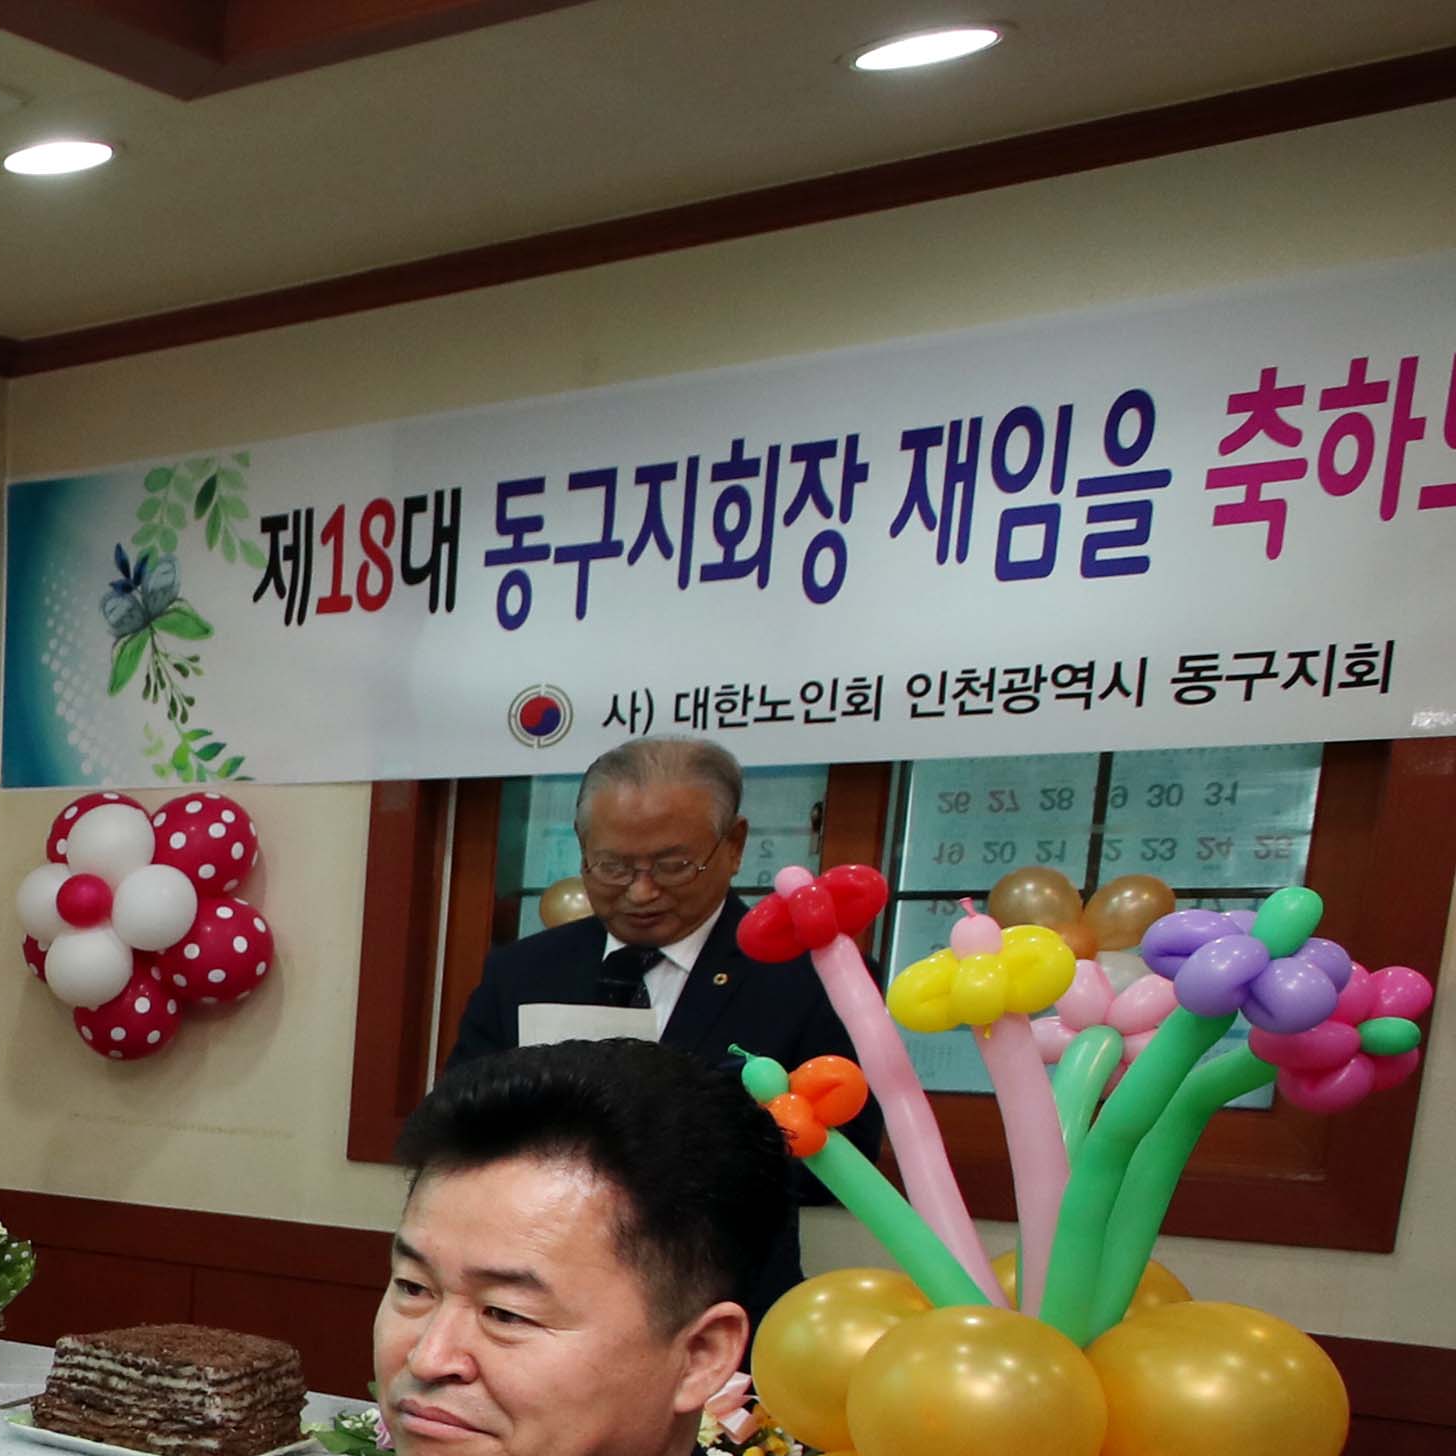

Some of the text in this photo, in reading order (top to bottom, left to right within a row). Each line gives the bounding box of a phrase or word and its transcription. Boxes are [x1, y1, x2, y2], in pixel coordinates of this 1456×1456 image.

[252, 486, 462, 627] 제18대
[484, 433, 870, 631] 동구지회장
[889, 388, 1172, 582] 재임을
[601, 639, 1397, 736] 사) 대한노인회 인천광역시 동구지회
